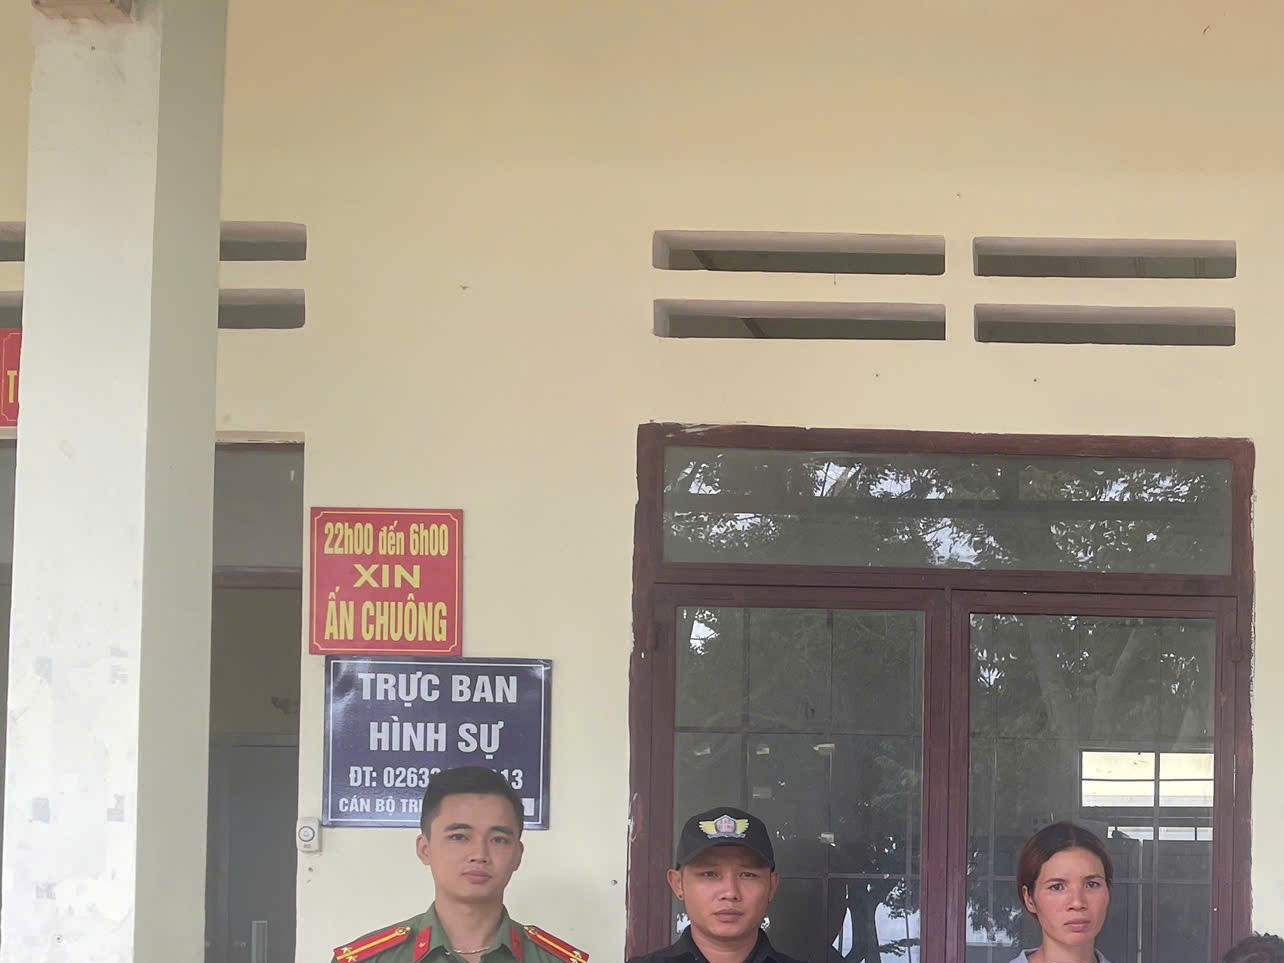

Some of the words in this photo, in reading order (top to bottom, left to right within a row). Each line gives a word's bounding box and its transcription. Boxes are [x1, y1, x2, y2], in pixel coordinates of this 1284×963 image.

[324, 521, 374, 555] 22h00
[378, 520, 405, 556] đến
[409, 523, 449, 556] 6h00
[353, 563, 421, 588] XIN
[324, 586, 355, 640] ẤN
[361, 593, 448, 642] CHUÔNG
[358, 671, 440, 707] TRỰC
[451, 674, 518, 703] BAN
[369, 715, 447, 752] HÌNH
[457, 721, 505, 760] SỰ
[348, 766, 377, 787] ĐT:
[339, 794, 371, 813] CÁN
[375, 795, 396, 816] BỘ
